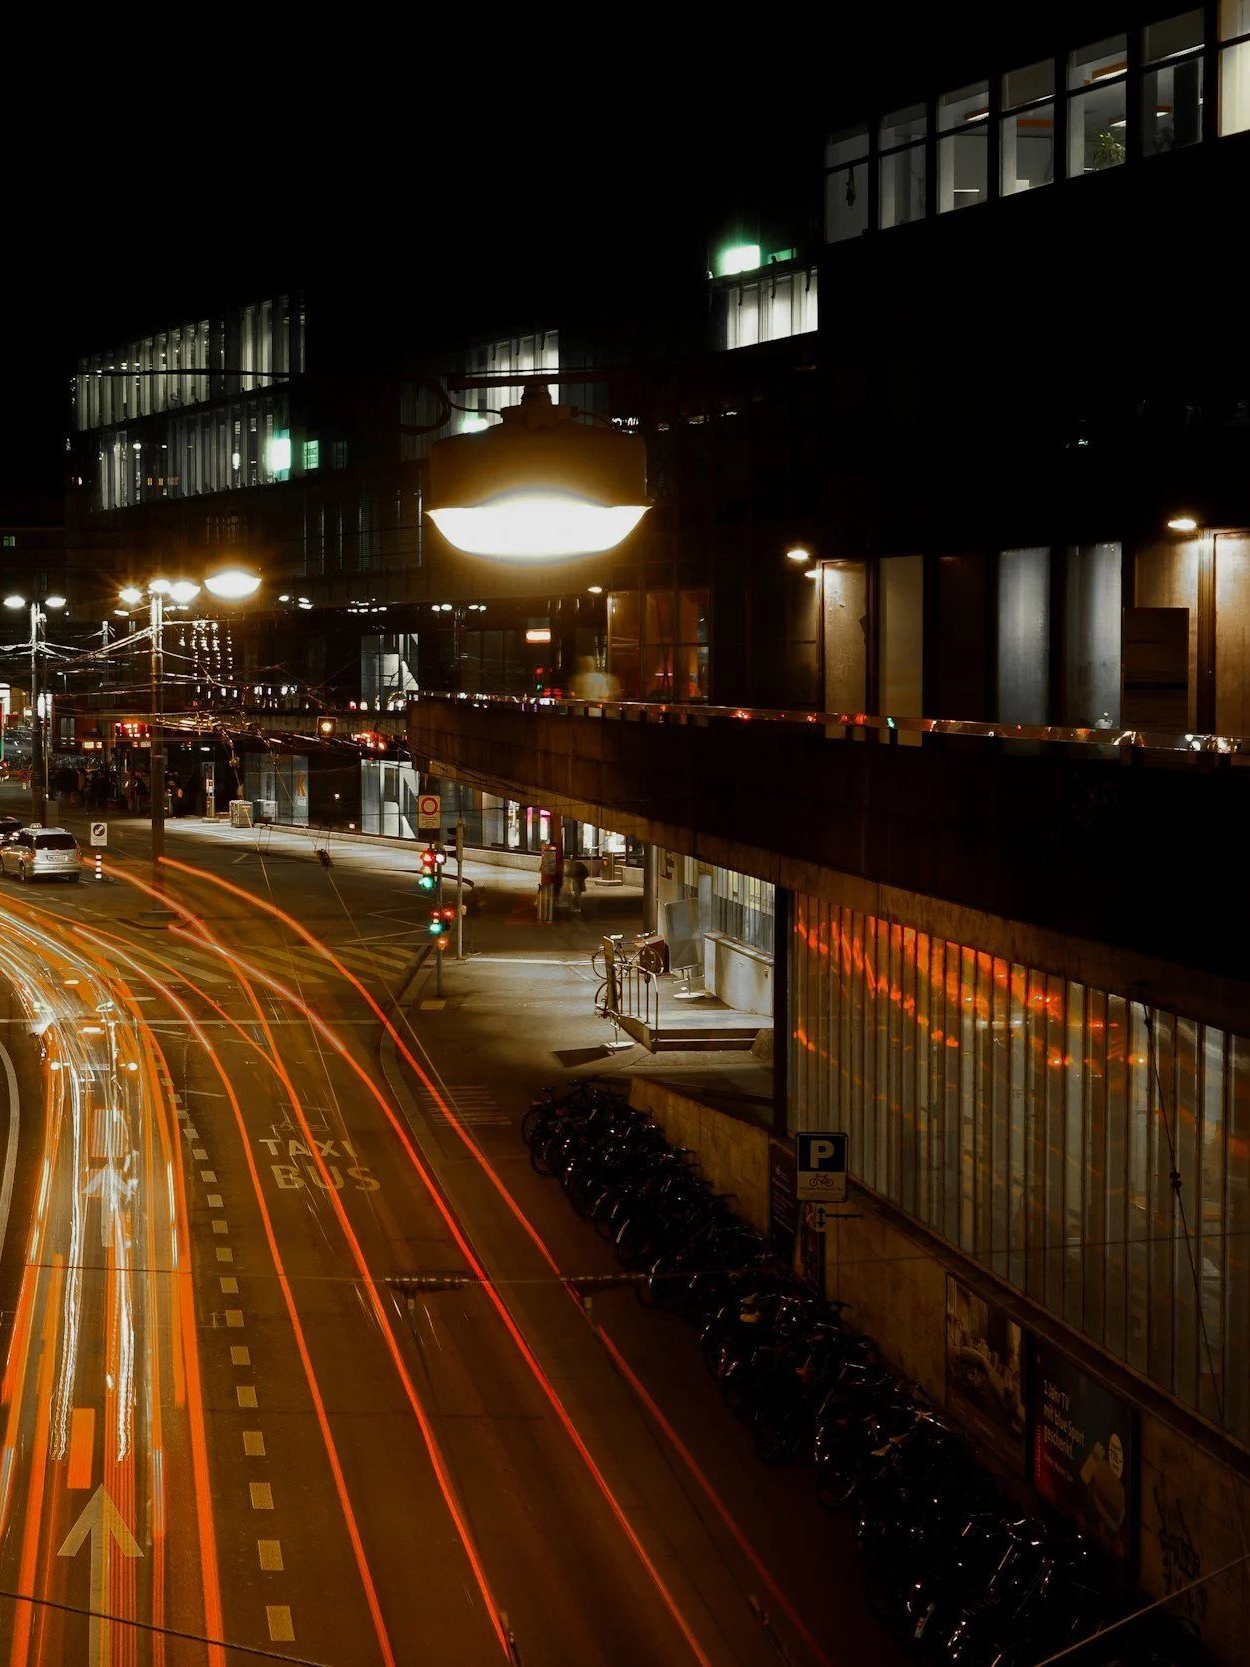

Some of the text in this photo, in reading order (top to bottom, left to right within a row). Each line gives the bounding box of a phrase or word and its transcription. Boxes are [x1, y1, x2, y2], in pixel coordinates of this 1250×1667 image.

[259, 1138, 359, 1157] TAXI
[810, 1140, 835, 1169] P
[270, 1164, 381, 1191] BUS
[1060, 1391, 1071, 1412] TV
[1068, 1420, 1085, 1448] Sport
